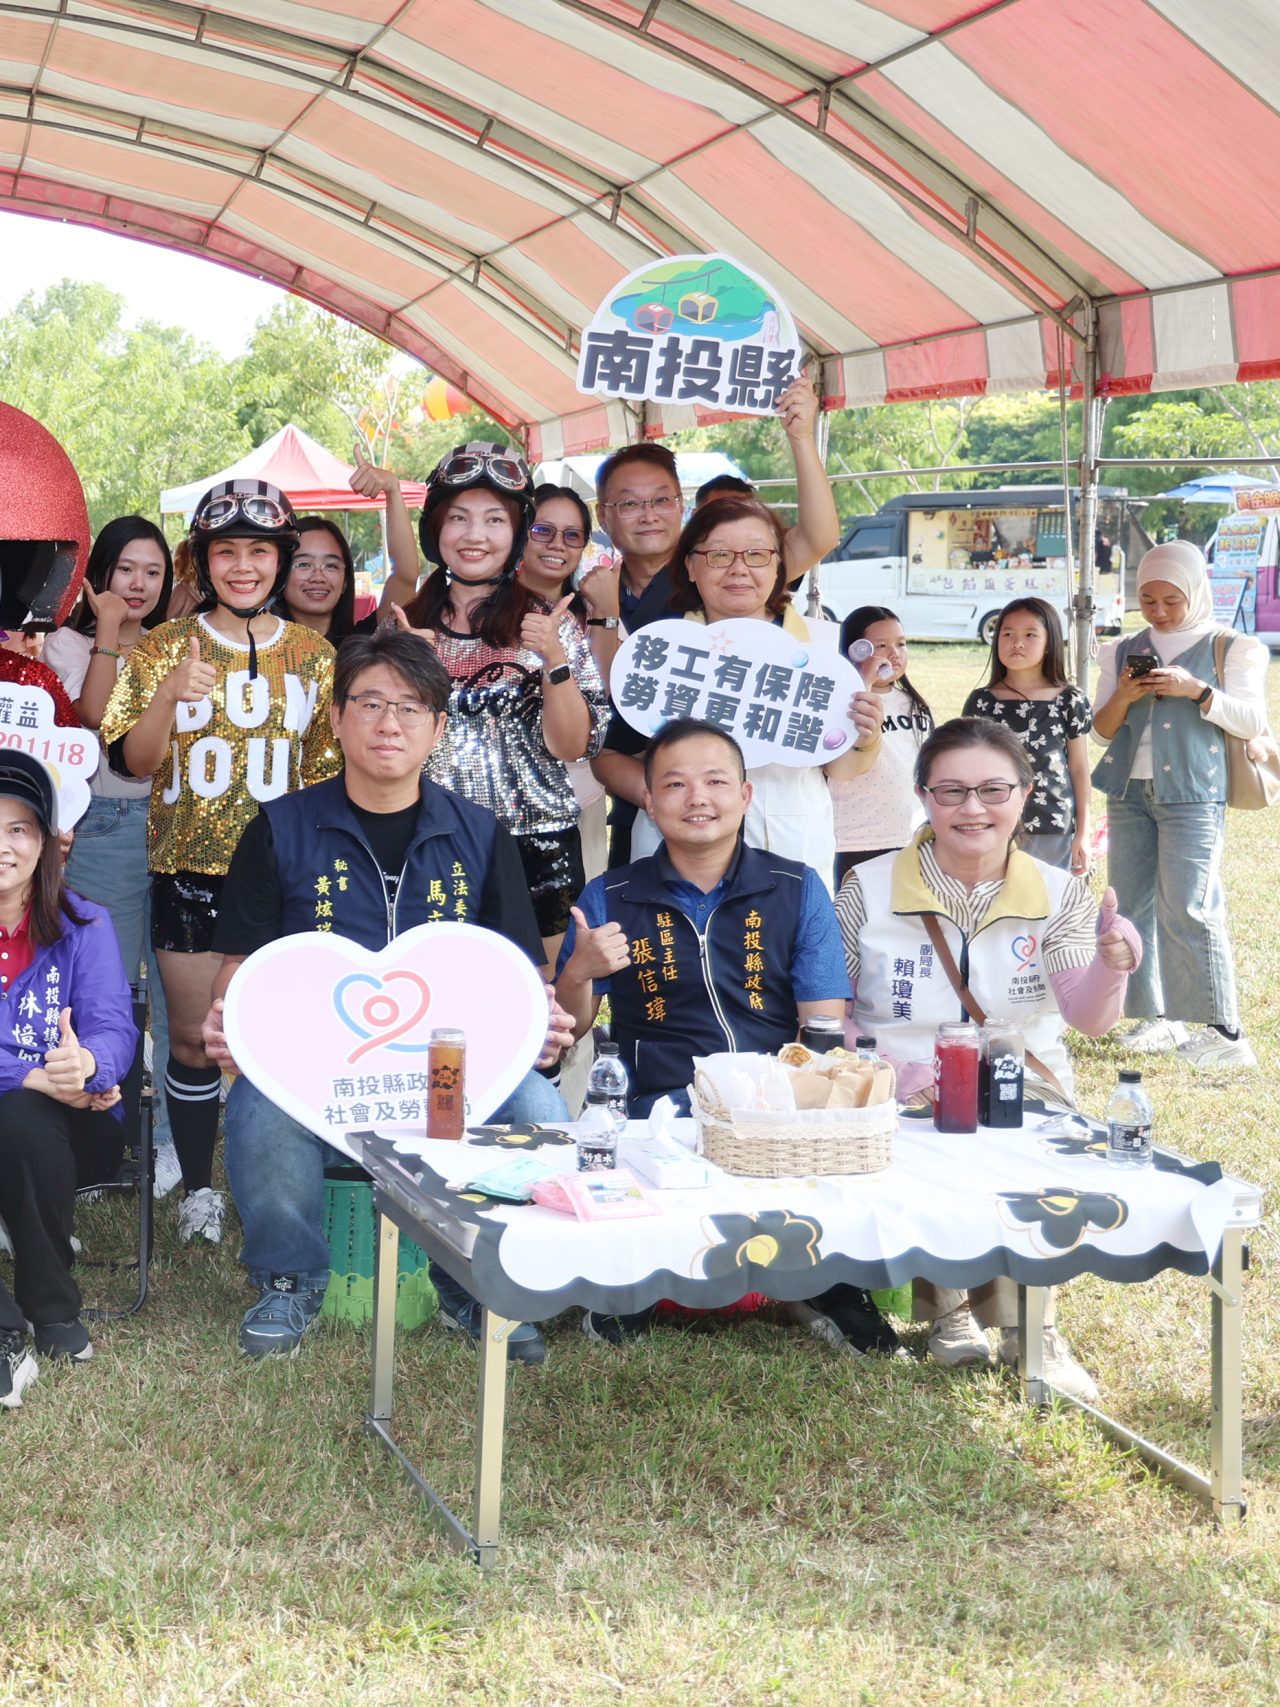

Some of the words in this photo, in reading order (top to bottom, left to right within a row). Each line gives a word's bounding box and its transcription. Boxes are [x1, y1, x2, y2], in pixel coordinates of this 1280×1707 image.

[582, 330, 796, 410] 南投縣
[632, 635, 835, 713] 移工有保障
[620, 673, 823, 754] 勞資更和諧
[163, 736, 304, 804] JOU
[334, 859, 349, 891] 秘書
[656, 912, 678, 981] 駐區主任
[744, 910, 765, 1011] 南投縣政府
[920, 944, 932, 979] 副局長
[891, 957, 915, 1021] 賴瓊美
[333, 1072, 428, 1097] 南投縣政
